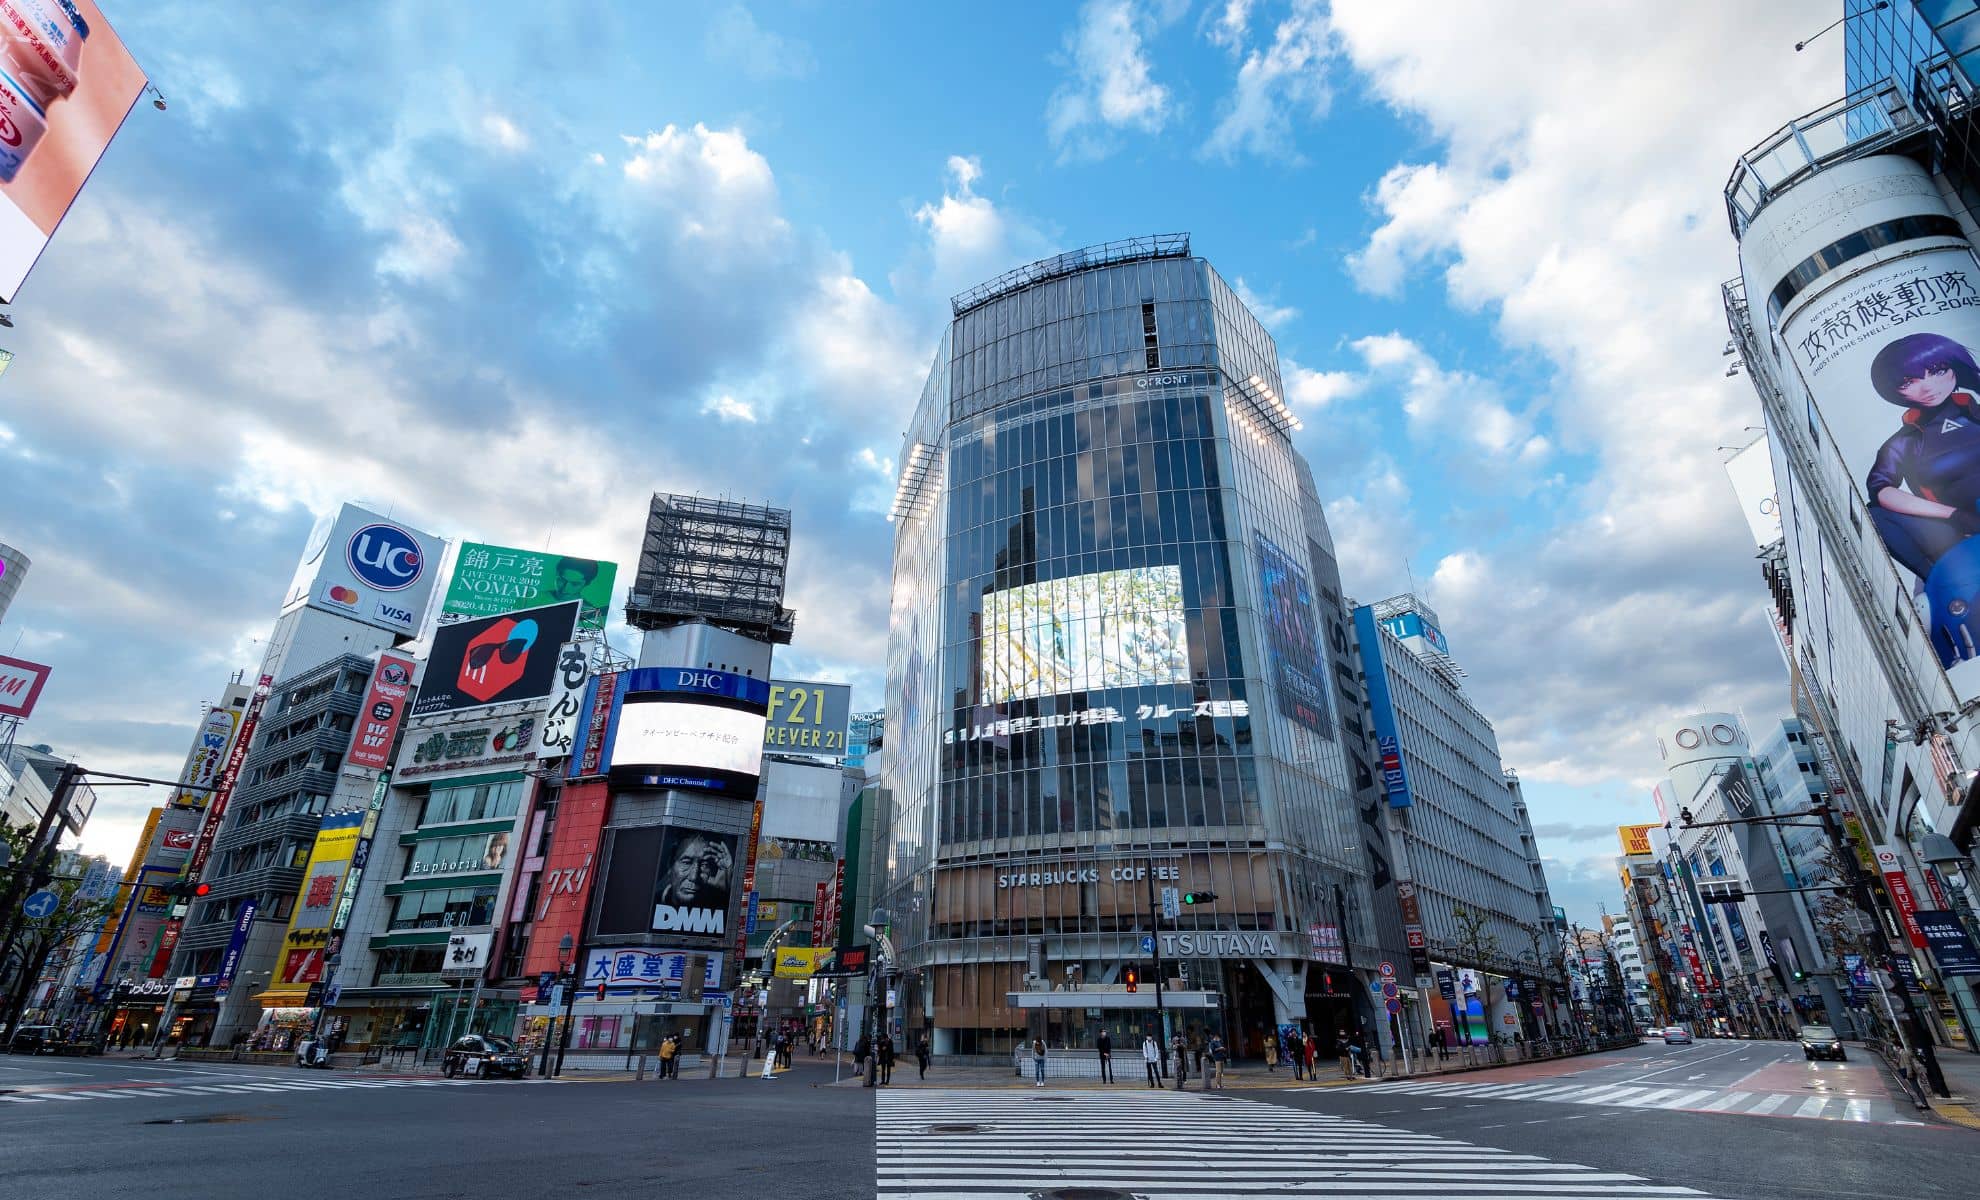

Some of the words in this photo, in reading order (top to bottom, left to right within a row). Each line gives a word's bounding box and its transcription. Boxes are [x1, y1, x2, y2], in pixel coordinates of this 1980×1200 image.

[1798, 270, 1976, 366] 攻殻機動隊
[1810, 302, 1839, 324] NETFLIX
[462, 549, 545, 576] 錦戸亮
[458, 577, 537, 599] NOMAD
[461, 570, 485, 579] LIVE
[488, 572, 517, 583] TOUR
[519, 577, 540, 586] 2019
[380, 604, 412, 624] VISA
[678, 671, 723, 690] DHC
[542, 643, 588, 753] もんじゃ
[766, 686, 825, 725] F21
[765, 726, 821, 747] REVER
[825, 730, 844, 749] 21
[1379, 734, 1406, 795] SEIBU
[663, 777, 680, 785] DHC
[681, 778, 707, 787] Channel
[413, 858, 480, 874] Euphoria
[999, 867, 1099, 888] STARBUCKS
[1111, 866, 1180, 882] COFFEE
[537, 852, 593, 921] クスリ
[240, 905, 254, 932] MIZUHO
[653, 903, 725, 934] DMM
[1161, 934, 1278, 956] TSUTAYA
